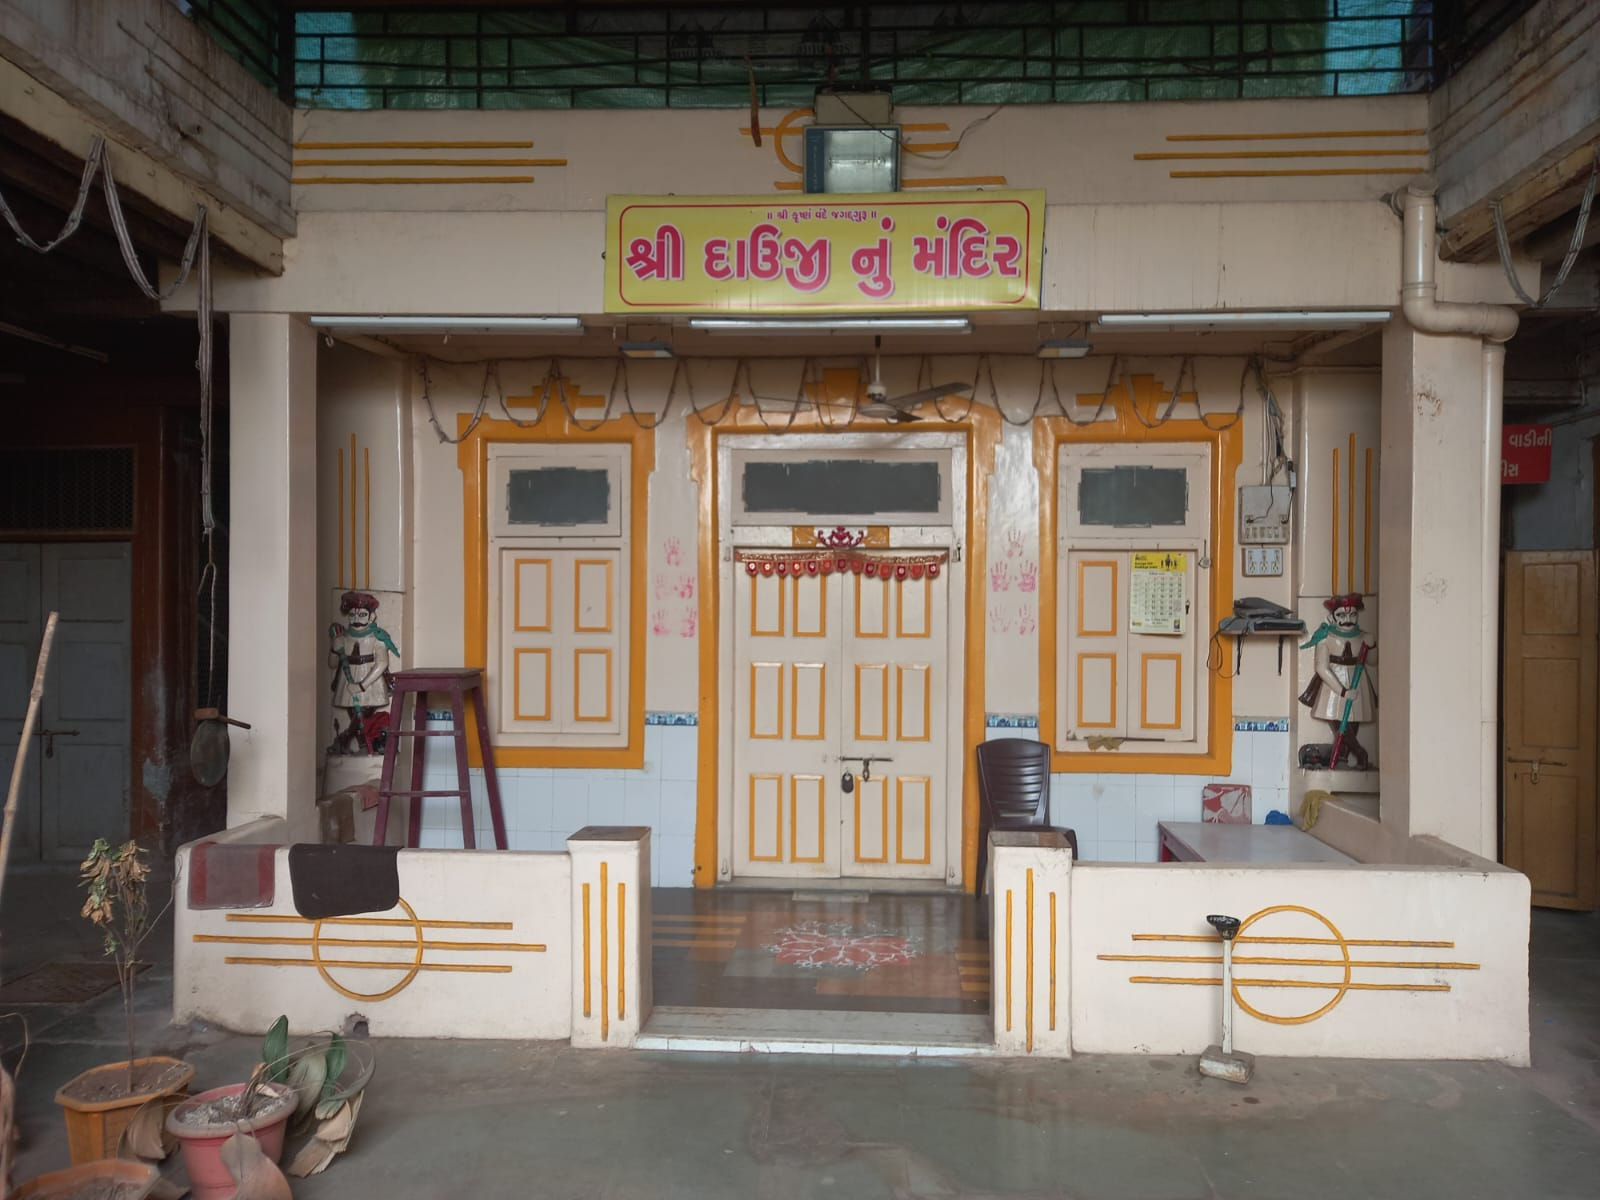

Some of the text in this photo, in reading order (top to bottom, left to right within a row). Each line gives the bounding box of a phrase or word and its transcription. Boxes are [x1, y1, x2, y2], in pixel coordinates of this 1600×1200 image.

[777, 209, 788, 219] શ્રી
[626, 214, 1020, 298] શ્રી દાઉજી નું મંદિર
